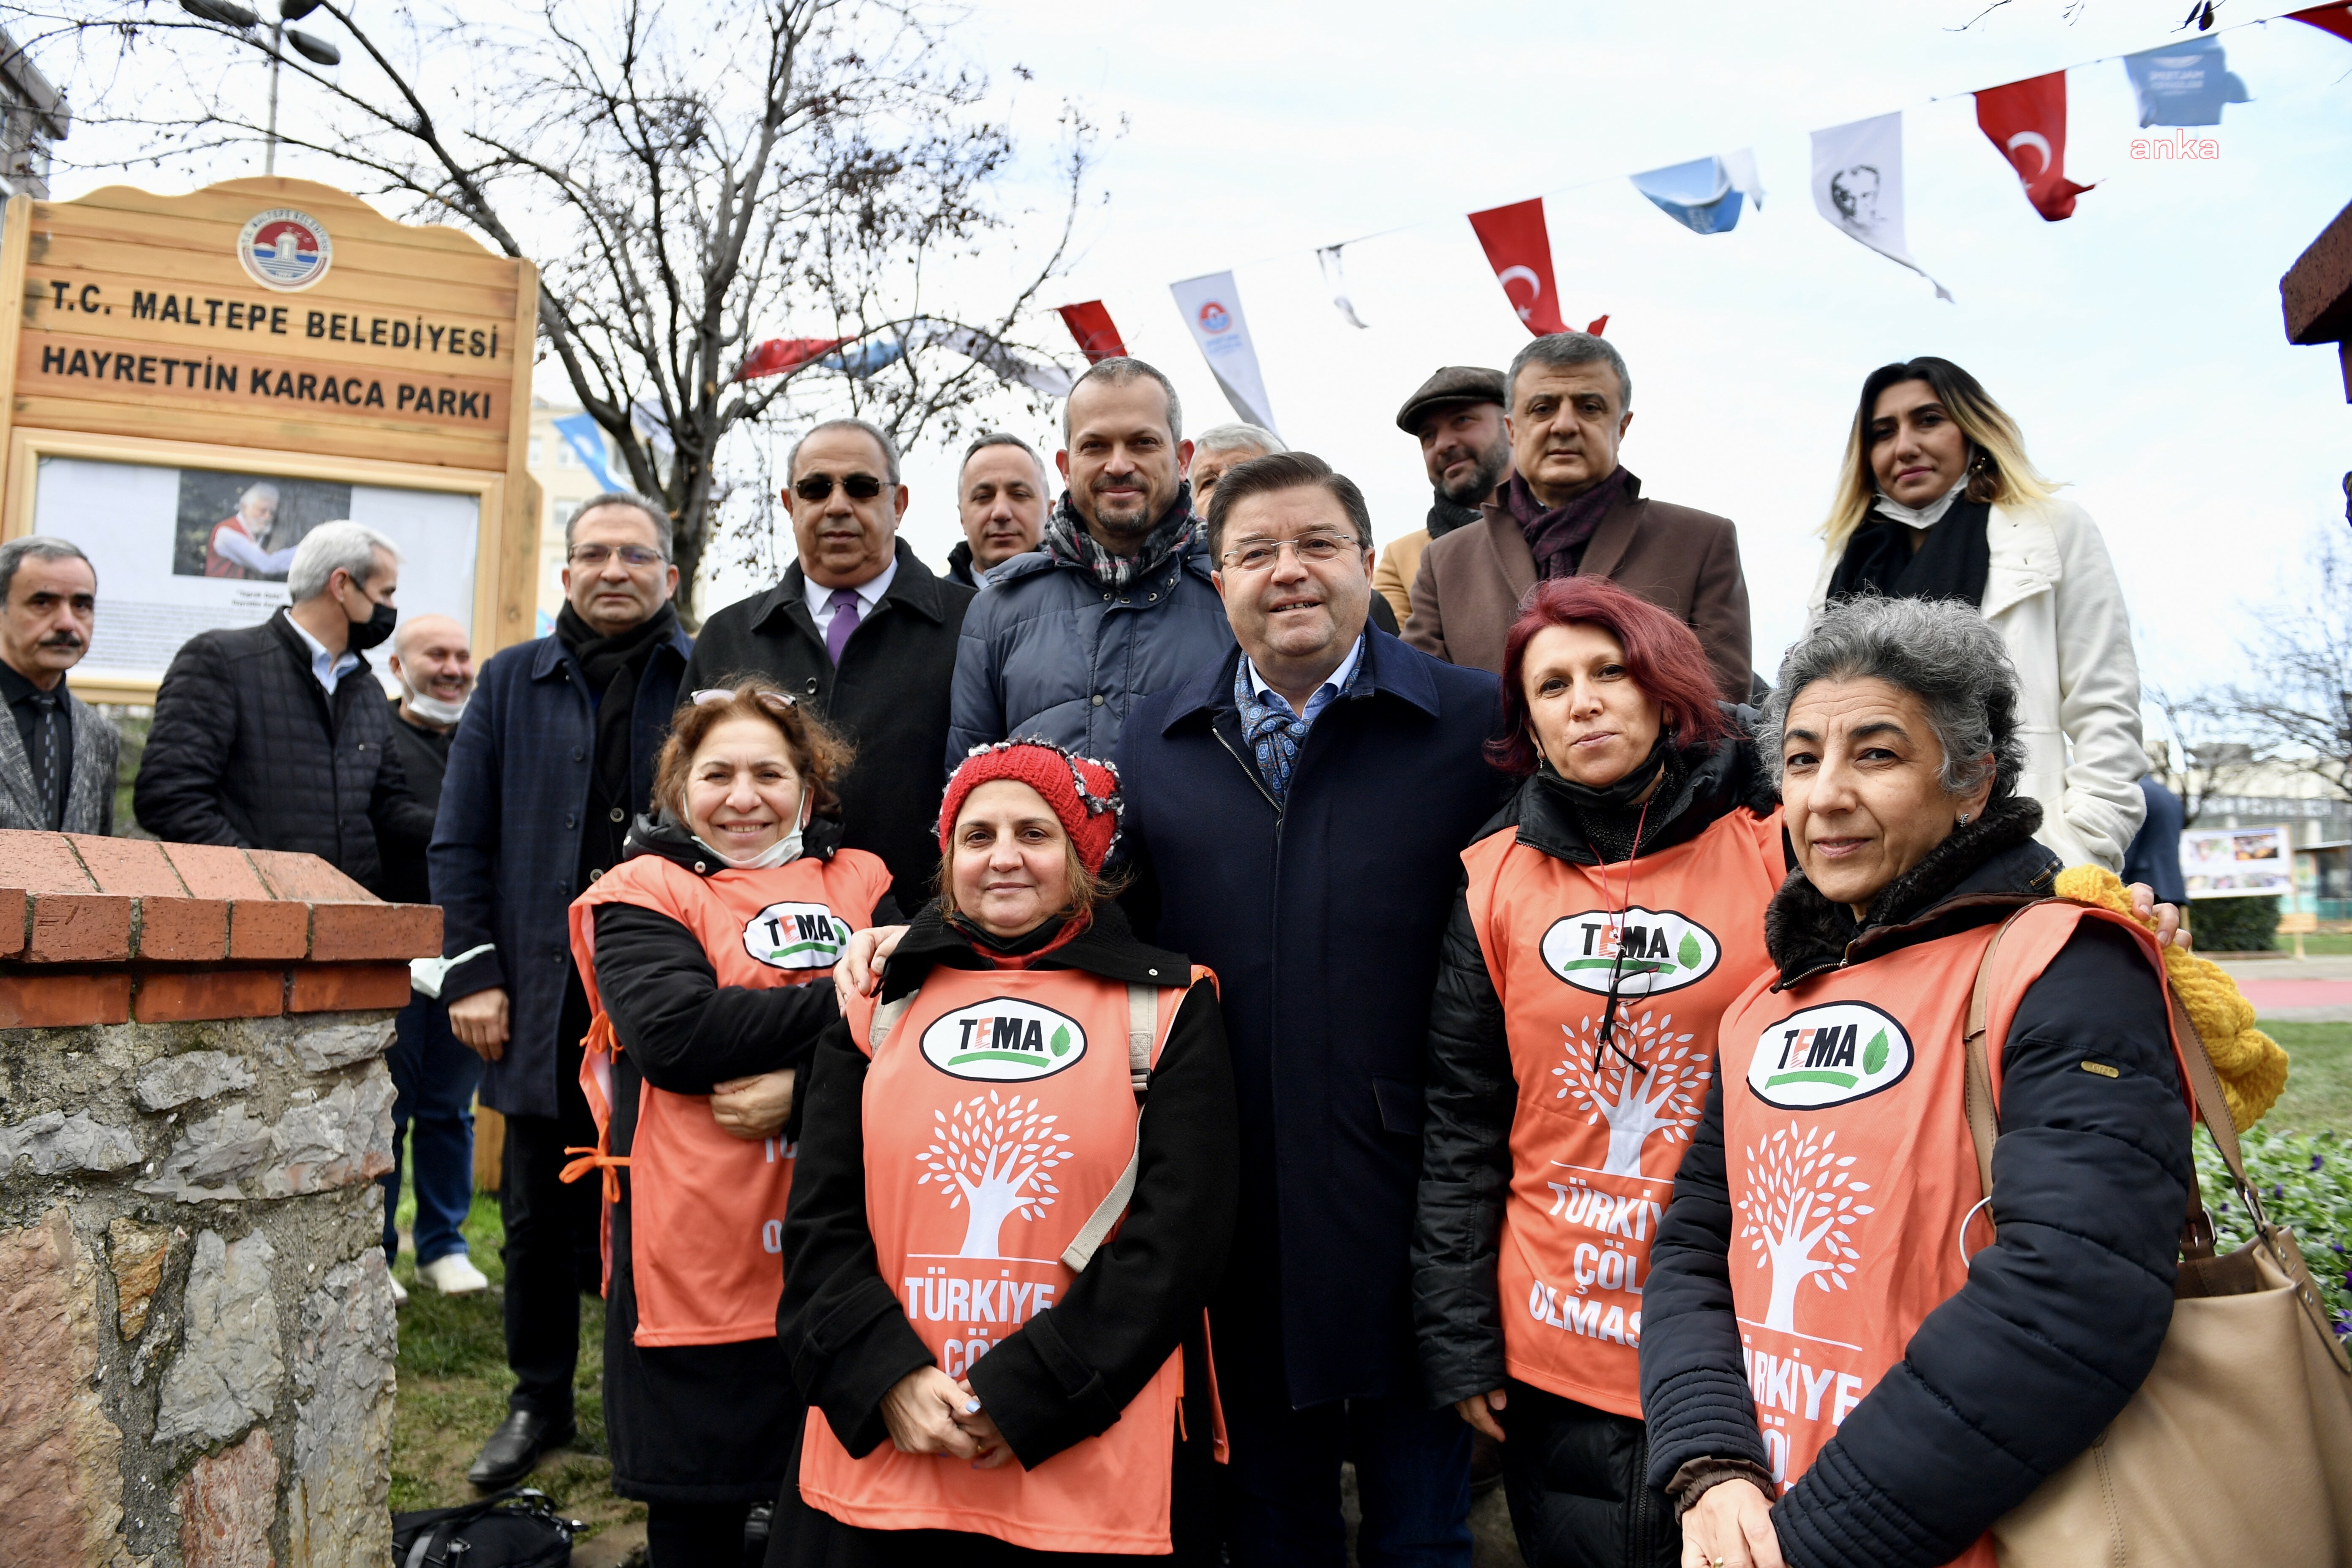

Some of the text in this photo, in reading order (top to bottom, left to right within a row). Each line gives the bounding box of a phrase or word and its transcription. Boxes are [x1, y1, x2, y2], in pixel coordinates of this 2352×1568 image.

[50, 280, 498, 359] T.C. MALTEPE BELEDİYESİ
[42, 345, 490, 419] HAYRETTİN KARACA PARKI
[764, 914, 835, 946] TEMA
[1581, 923, 1670, 958] TEMA
[959, 1016, 1043, 1051] TEMA
[1777, 1024, 1858, 1069] TEMA
[1547, 1176, 1664, 1241] TÜRKİ
[1573, 1239, 1643, 1295] ÇÖL
[1529, 1279, 1642, 1349] OLMAS
[1742, 1334, 1862, 1427] ÜRKİYE
[1762, 1413, 1796, 1492] ÖL
